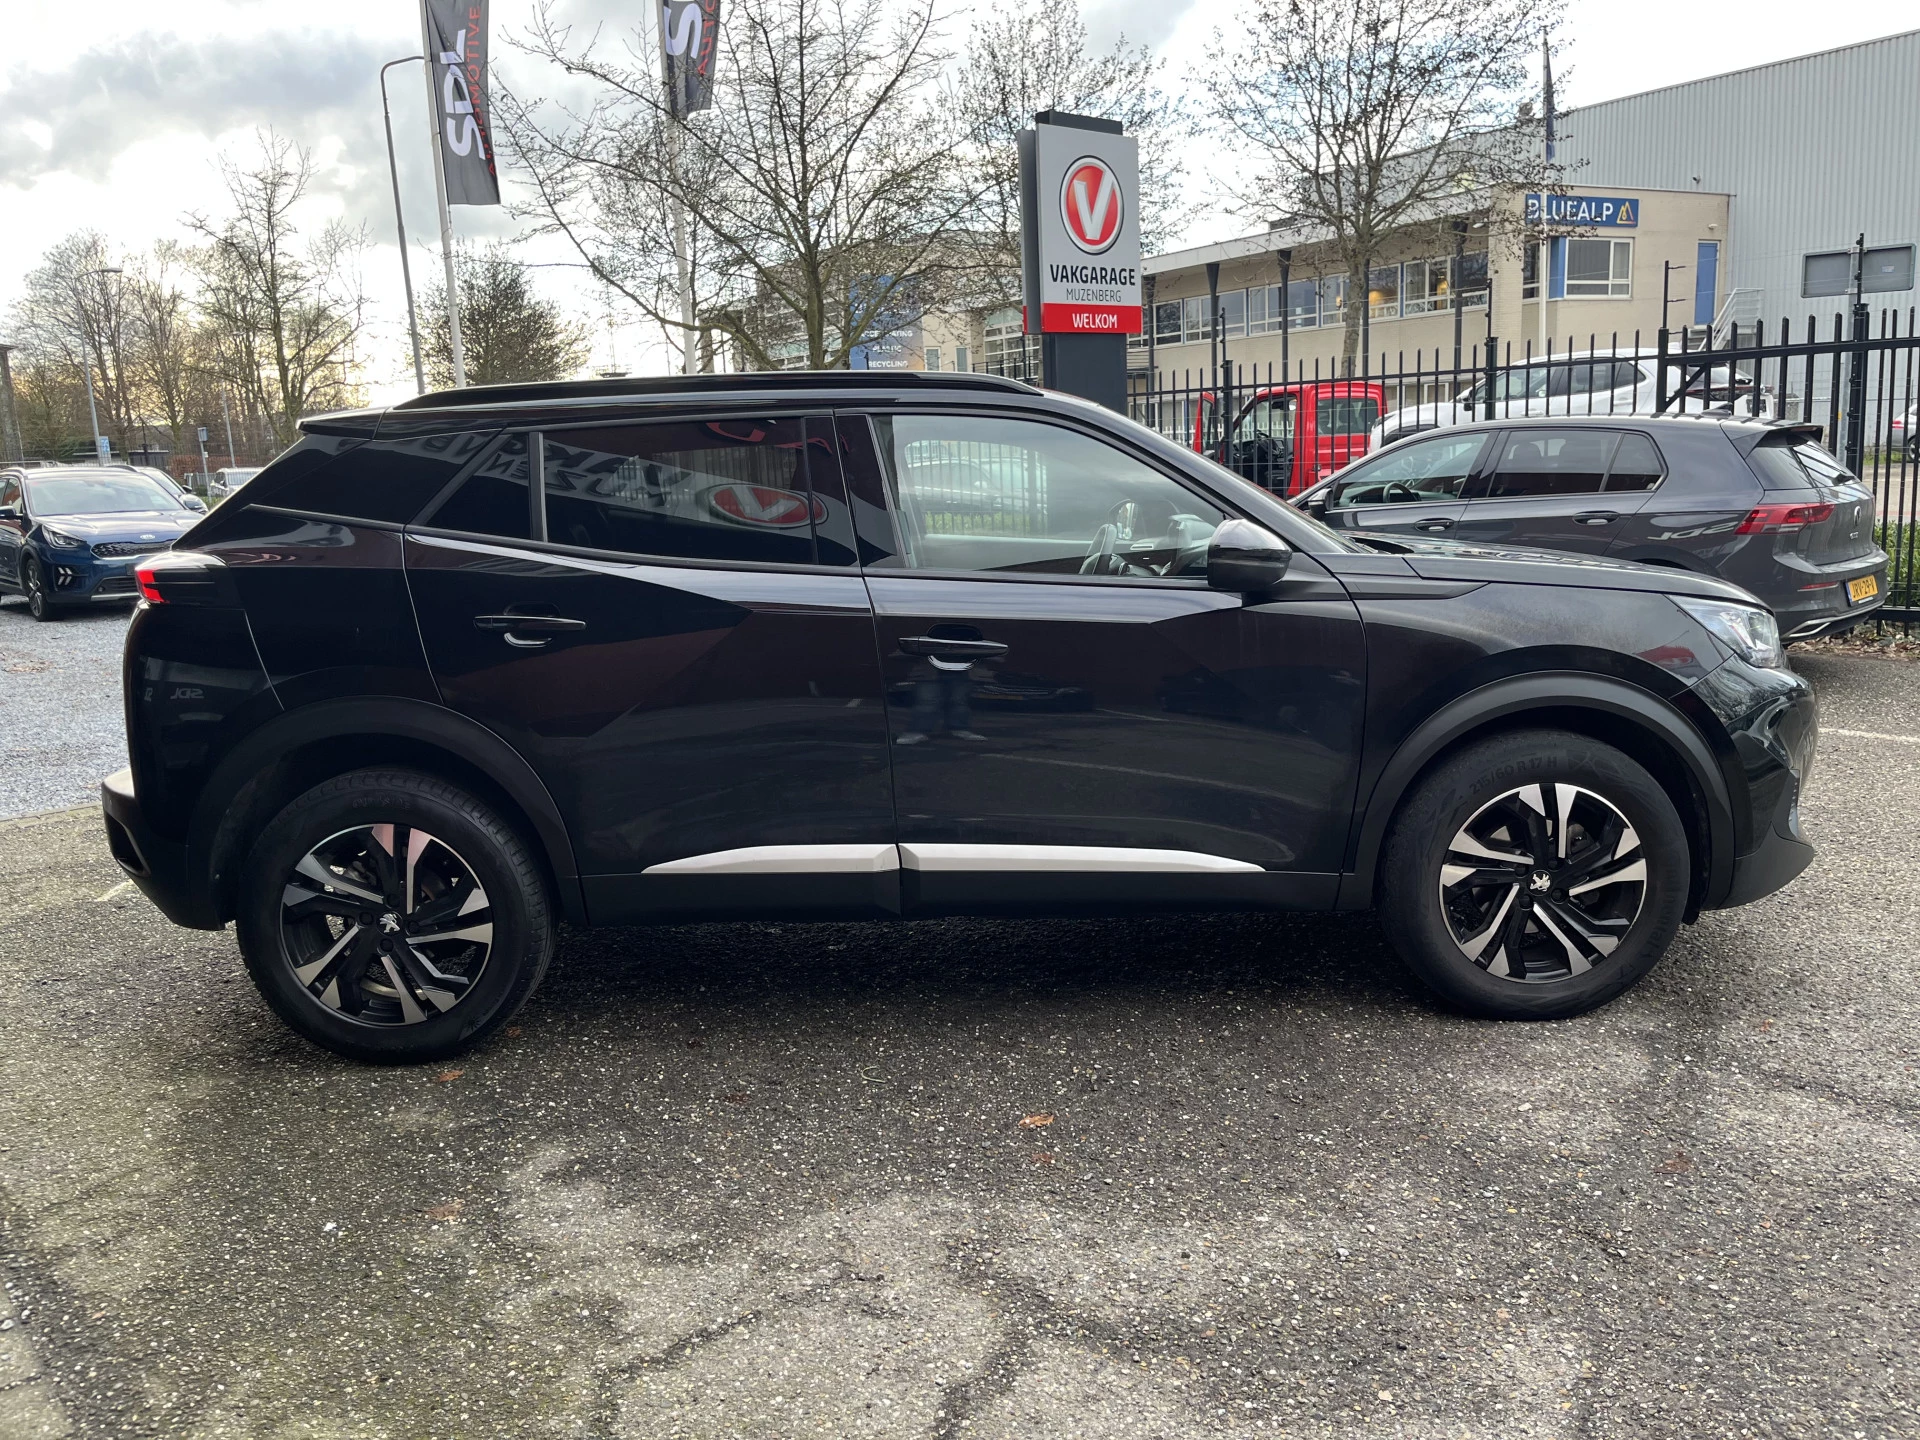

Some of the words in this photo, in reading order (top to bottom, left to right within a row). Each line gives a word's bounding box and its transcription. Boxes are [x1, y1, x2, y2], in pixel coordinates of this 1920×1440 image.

[440, 29, 486, 160] SDL
[1527, 199, 1614, 221] BLUEALP
[1050, 264, 1136, 286] VAKGARAGE
[1066, 288, 1121, 302] MUZENBERG
[1072, 313, 1118, 329] WELKOM
